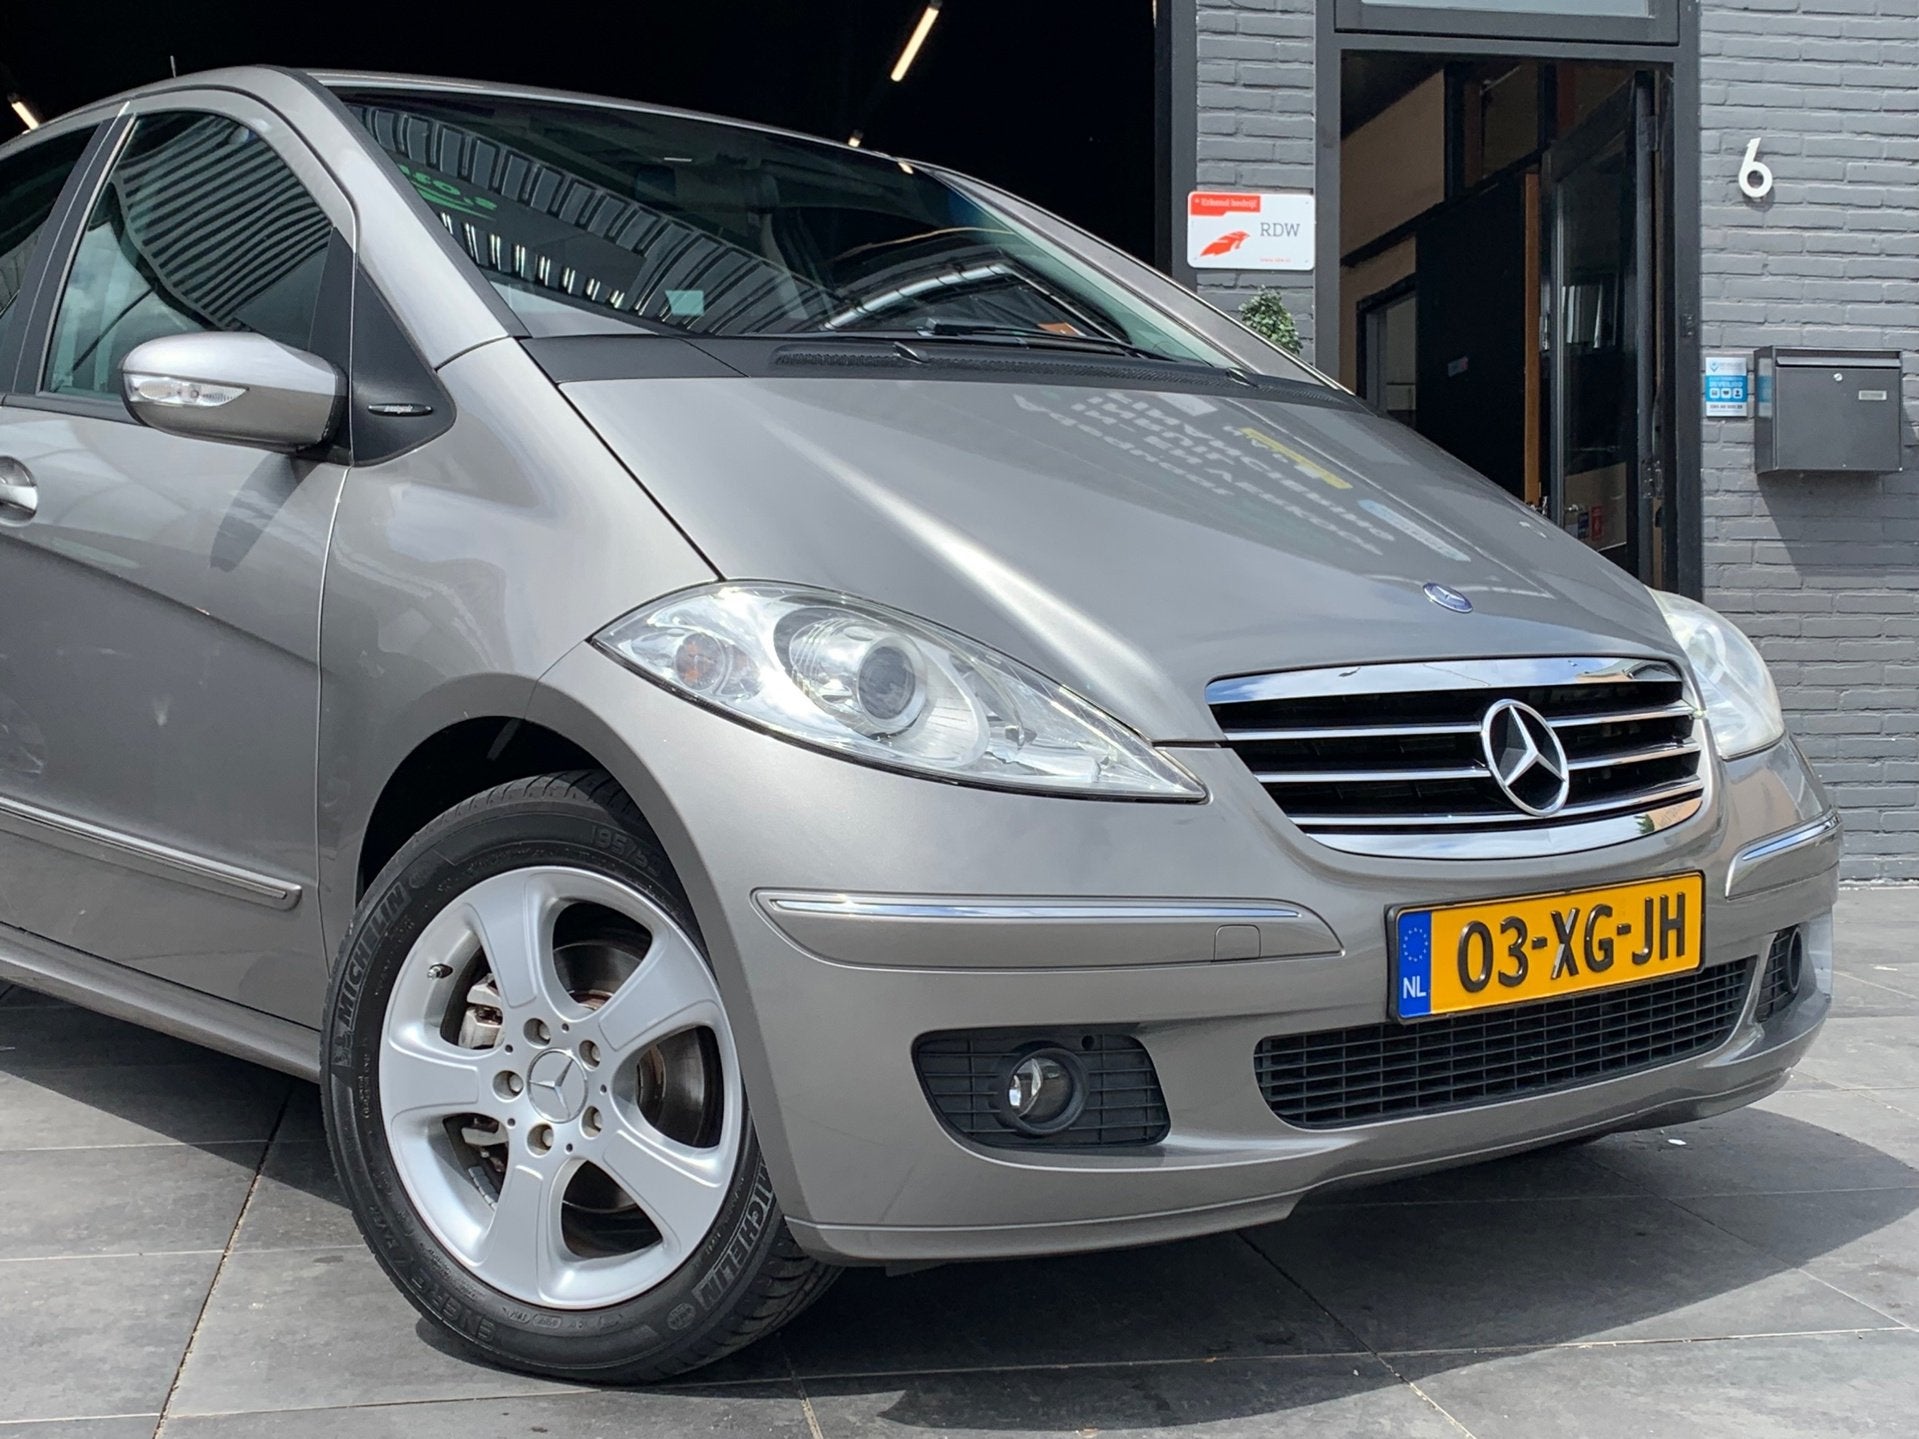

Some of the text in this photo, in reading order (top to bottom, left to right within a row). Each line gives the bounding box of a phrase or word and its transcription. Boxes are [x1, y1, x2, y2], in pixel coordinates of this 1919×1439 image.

[1738, 137, 1773, 198] 6
[1260, 222, 1300, 237] RDW
[336, 883, 407, 1031] MICHELIN
[1457, 891, 1686, 994] 03-XG-JH
[1402, 975, 1427, 1000] NL
